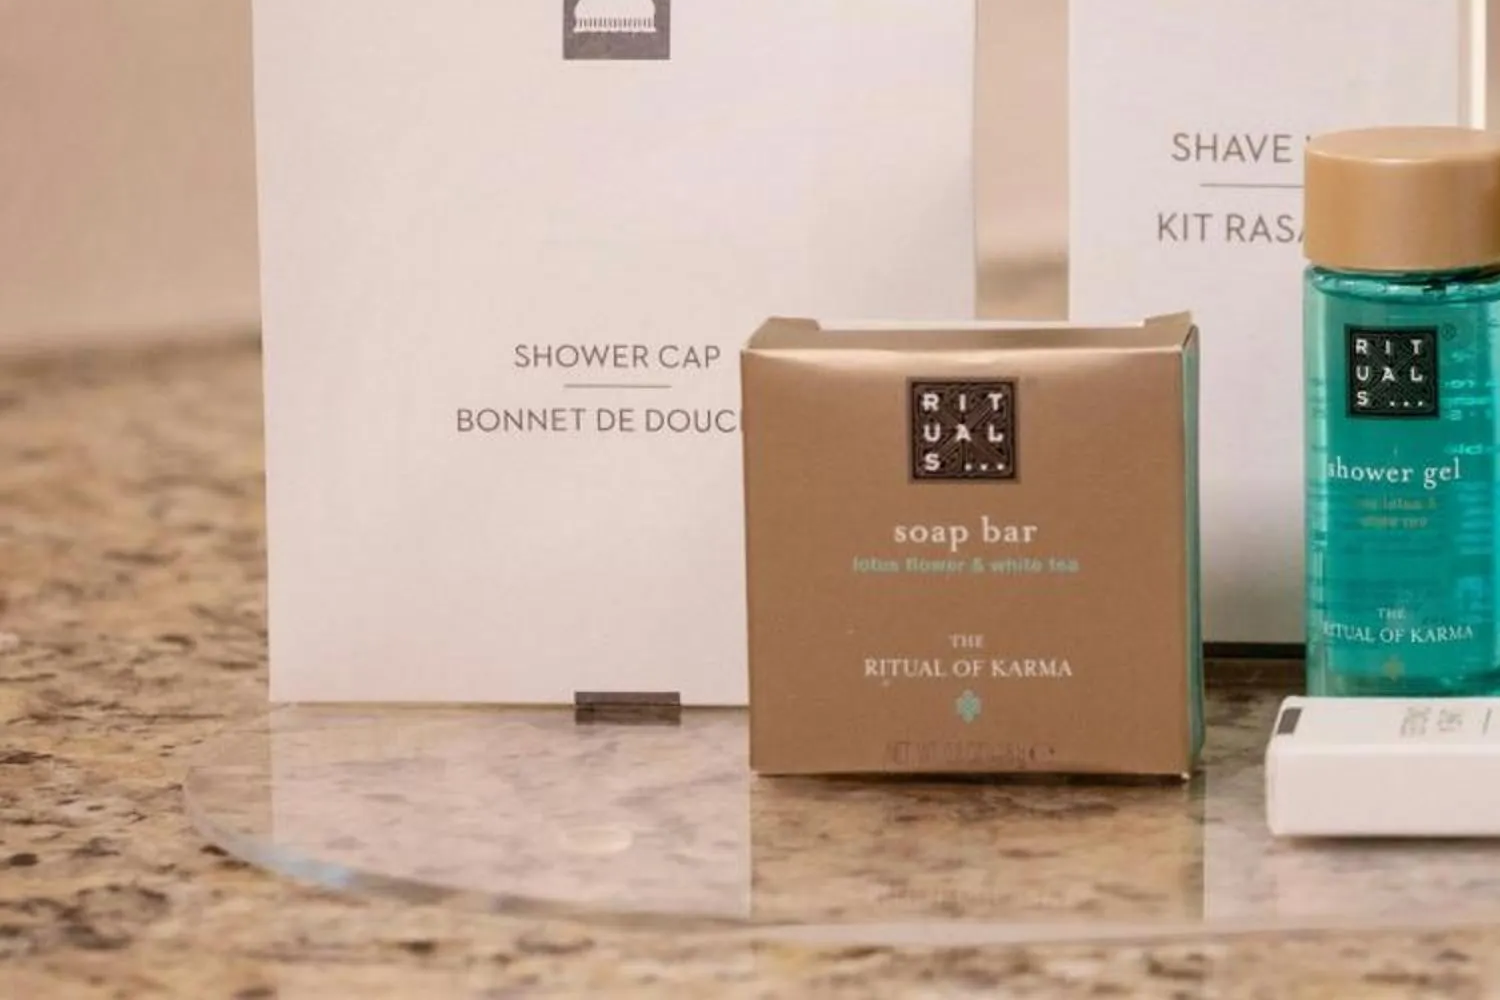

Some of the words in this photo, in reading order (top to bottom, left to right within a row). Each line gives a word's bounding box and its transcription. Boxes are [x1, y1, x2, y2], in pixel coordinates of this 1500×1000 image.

[1171, 132, 1294, 164] SHAVE
[1157, 212, 1214, 243] KIT
[513, 343, 650, 369] SHOWER
[657, 345, 722, 370] CAP
[456, 407, 587, 433] BONNET
[596, 409, 636, 433] DE
[645, 408, 737, 434] DOUC
[1327, 455, 1414, 483] shower
[1422, 456, 1463, 491] gel
[894, 524, 969, 552] soap
[980, 514, 1038, 543] bar
[949, 633, 984, 649] THE
[1379, 627, 1405, 644] OF
[1410, 624, 1474, 643] KARMA
[863, 658, 947, 678] RITUAL
[951, 657, 985, 678] OF
[990, 658, 1073, 678] KARMA
